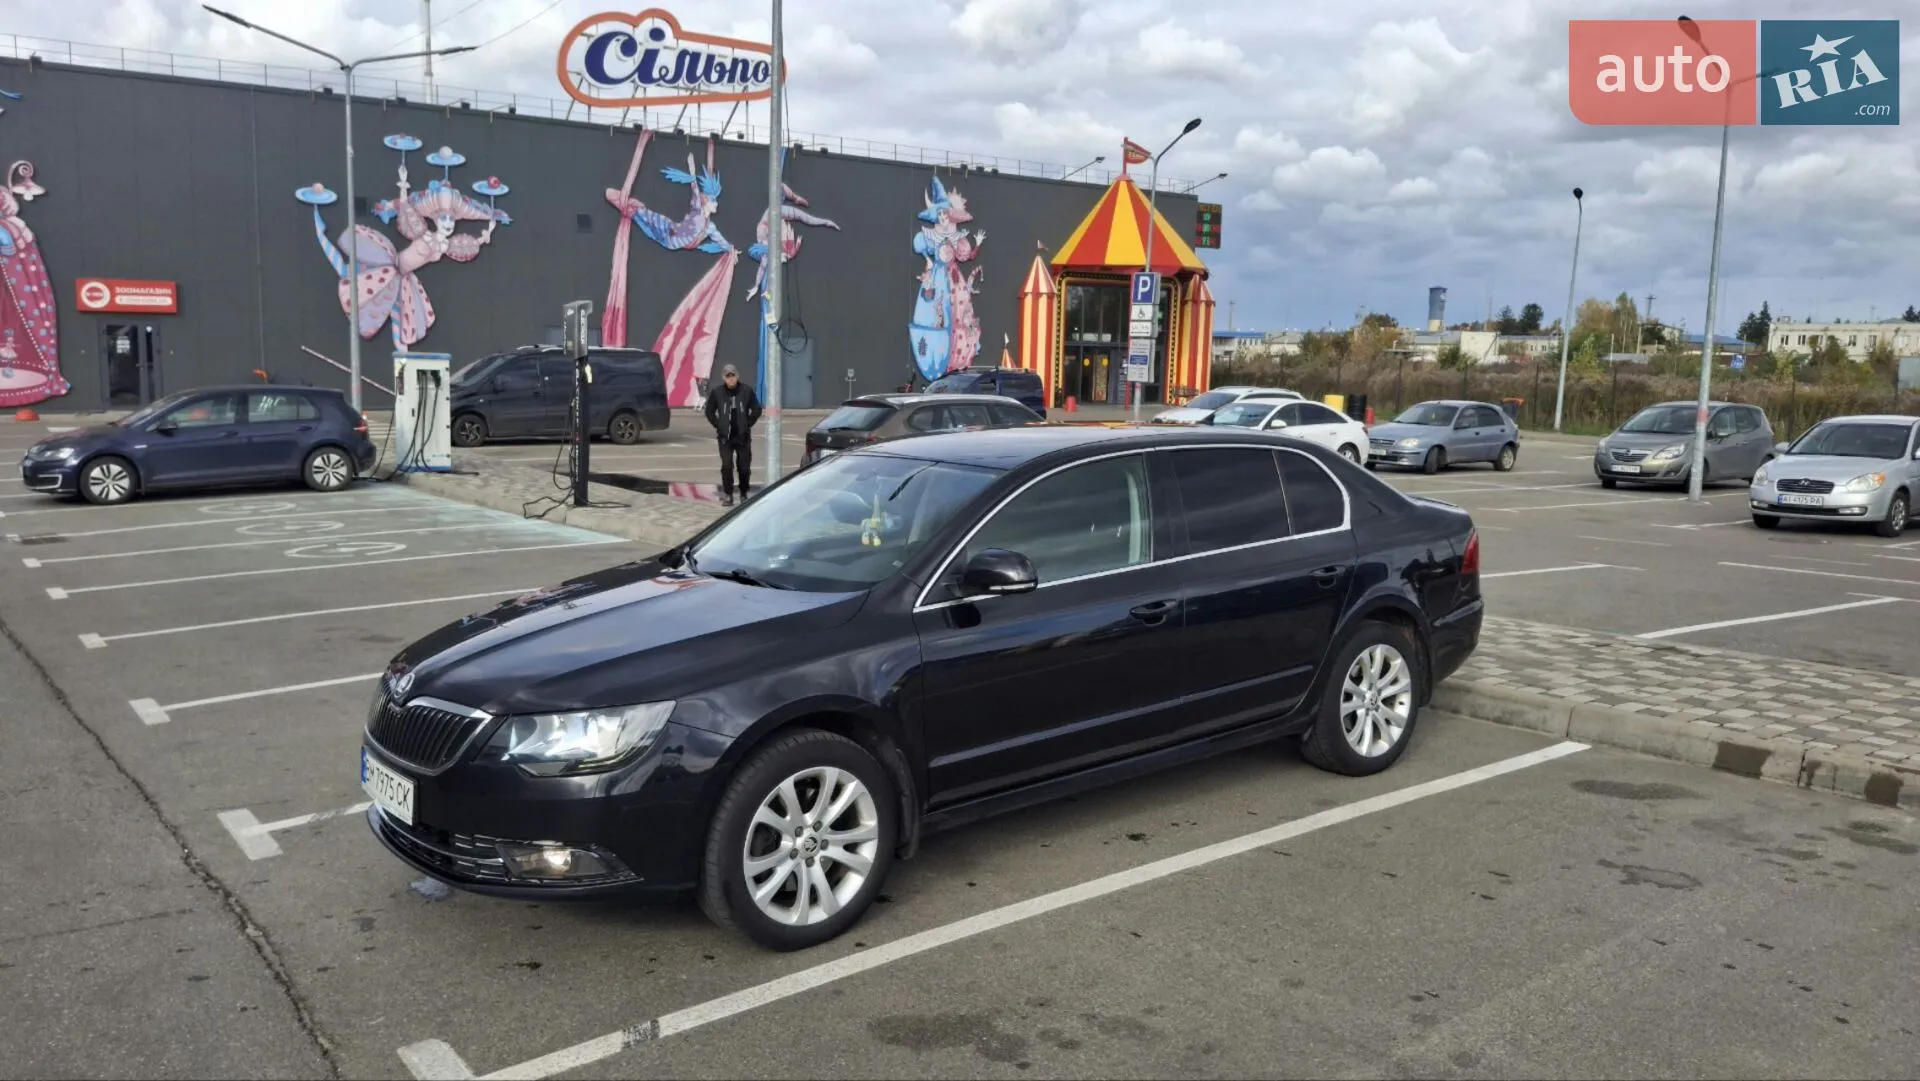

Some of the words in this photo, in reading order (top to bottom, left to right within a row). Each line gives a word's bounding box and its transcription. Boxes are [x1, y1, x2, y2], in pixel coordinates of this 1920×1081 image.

[585, 27, 771, 86] Сільпо
[1137, 275, 1151, 301] P
[376, 767, 395, 801] 7975
[397, 782, 410, 813] CK
